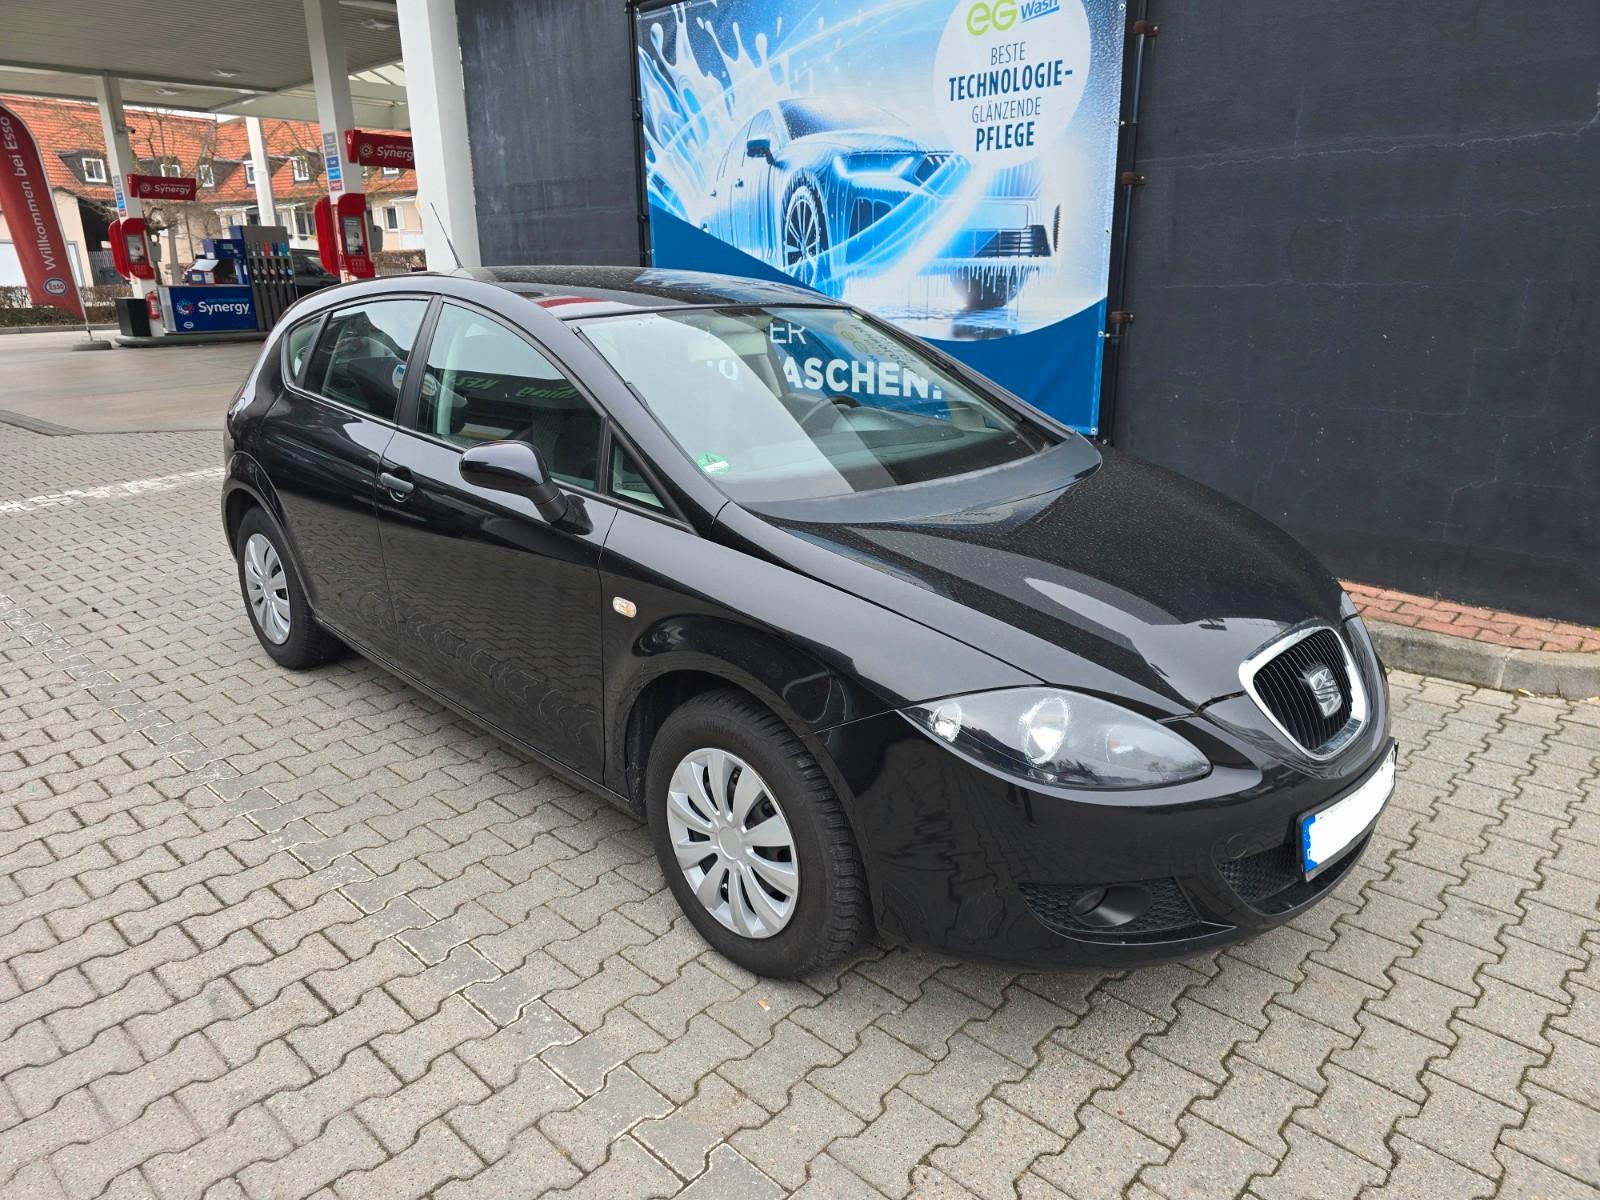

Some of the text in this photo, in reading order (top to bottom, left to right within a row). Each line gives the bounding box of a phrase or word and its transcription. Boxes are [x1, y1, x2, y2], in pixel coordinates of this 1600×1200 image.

[991, 41, 1026, 66] BESTE
[949, 59, 1073, 101] TECHNOLOGIE-
[972, 97, 1042, 124] GLÄNZENDE
[976, 121, 1035, 152] PFLEGE
[376, 146, 413, 161] Synerg
[0, 116, 57, 271] Willkommen bei Esso
[154, 184, 191, 195] Synergy
[198, 302, 250, 316] Synergy
[769, 323, 807, 345] ER
